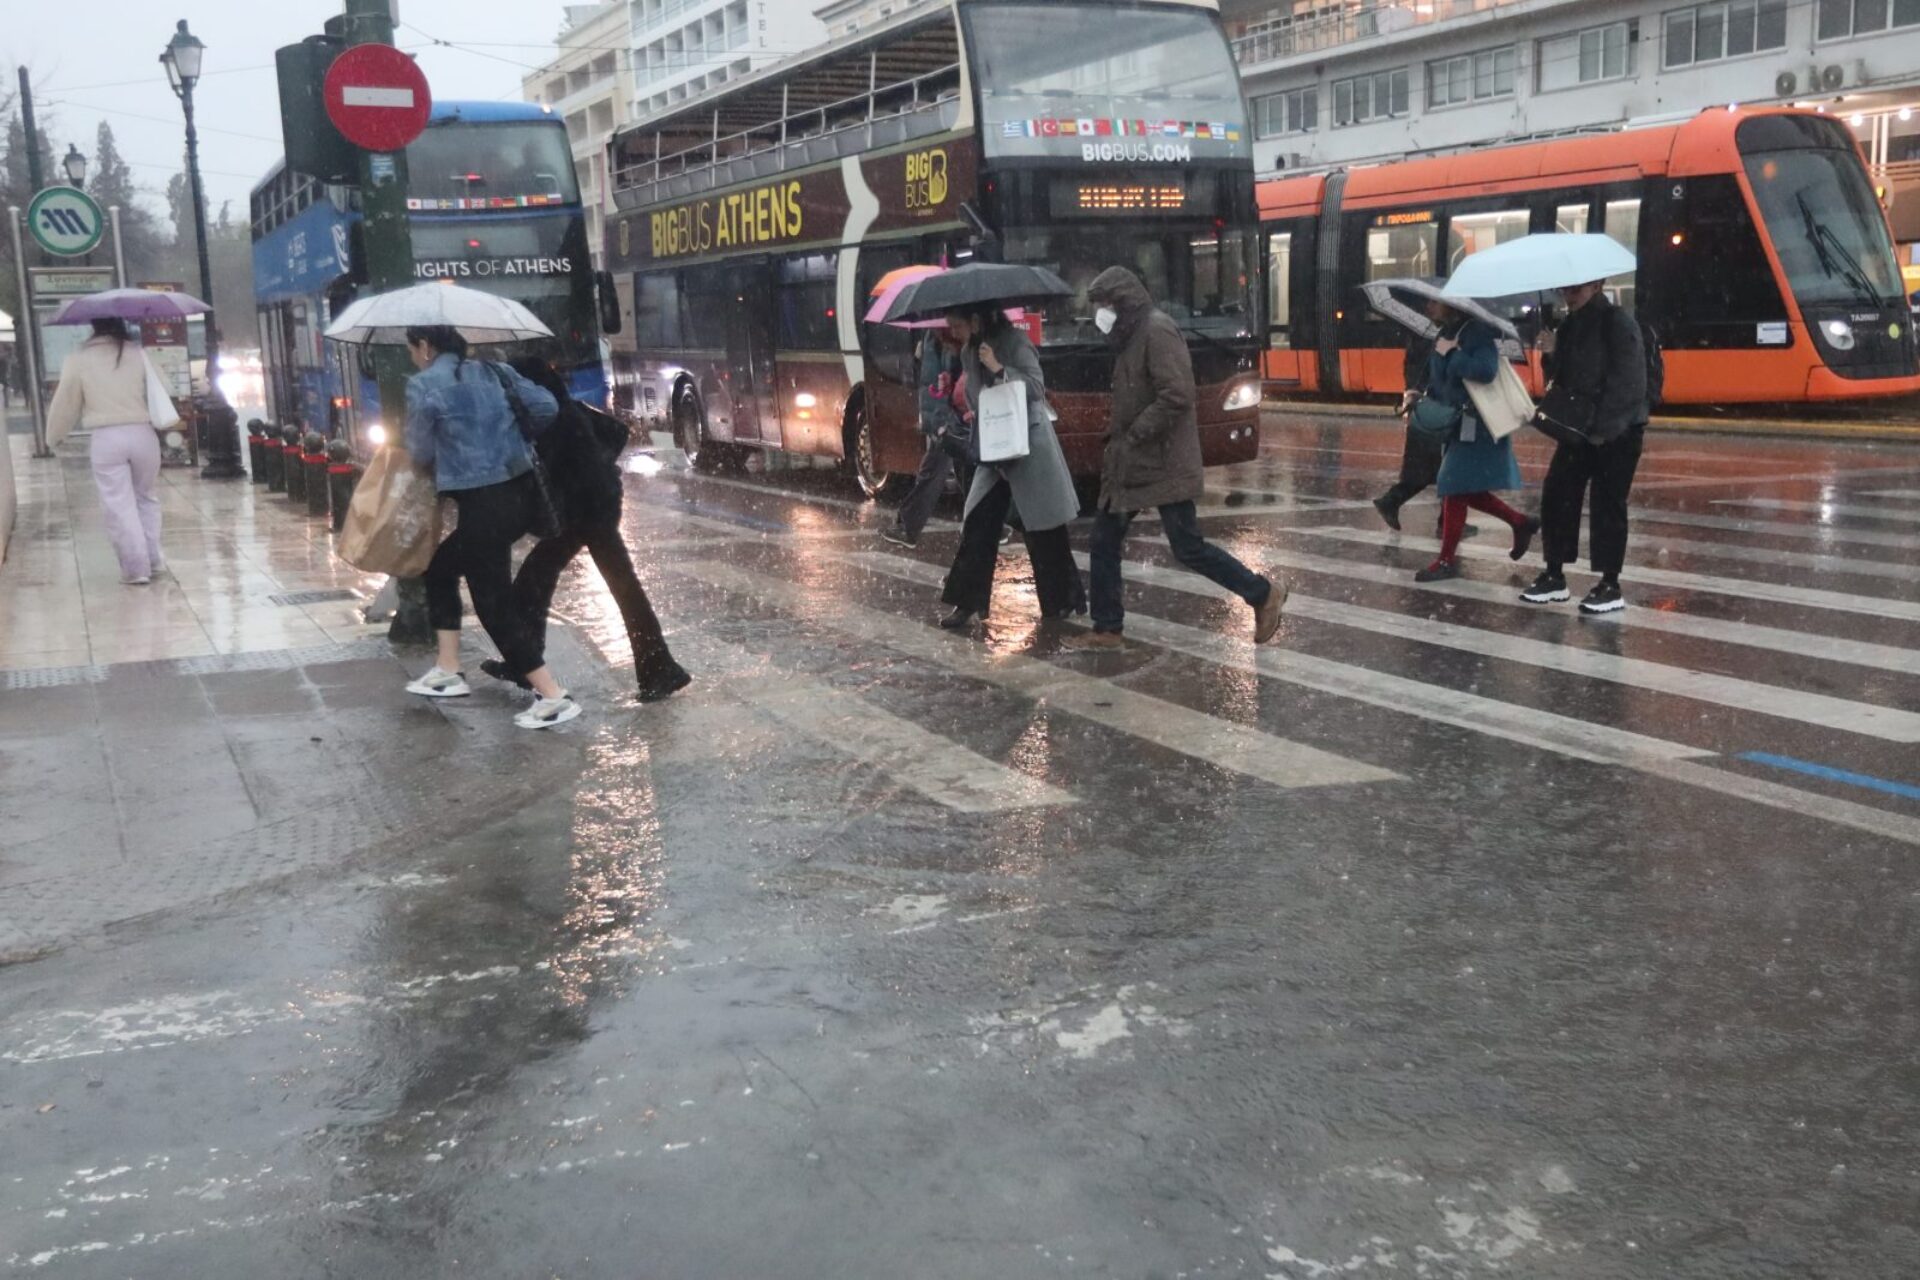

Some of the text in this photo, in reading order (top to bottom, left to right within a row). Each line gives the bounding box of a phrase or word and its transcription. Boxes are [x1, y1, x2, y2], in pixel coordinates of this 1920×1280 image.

[1082, 143, 1191, 162] BIGBUS.COM
[906, 152, 929, 182] BIG
[905, 181, 928, 208] BUS
[652, 181, 802, 257] BIGBUS ATHENS
[413, 258, 572, 278] IGHTS OF ATHENS
